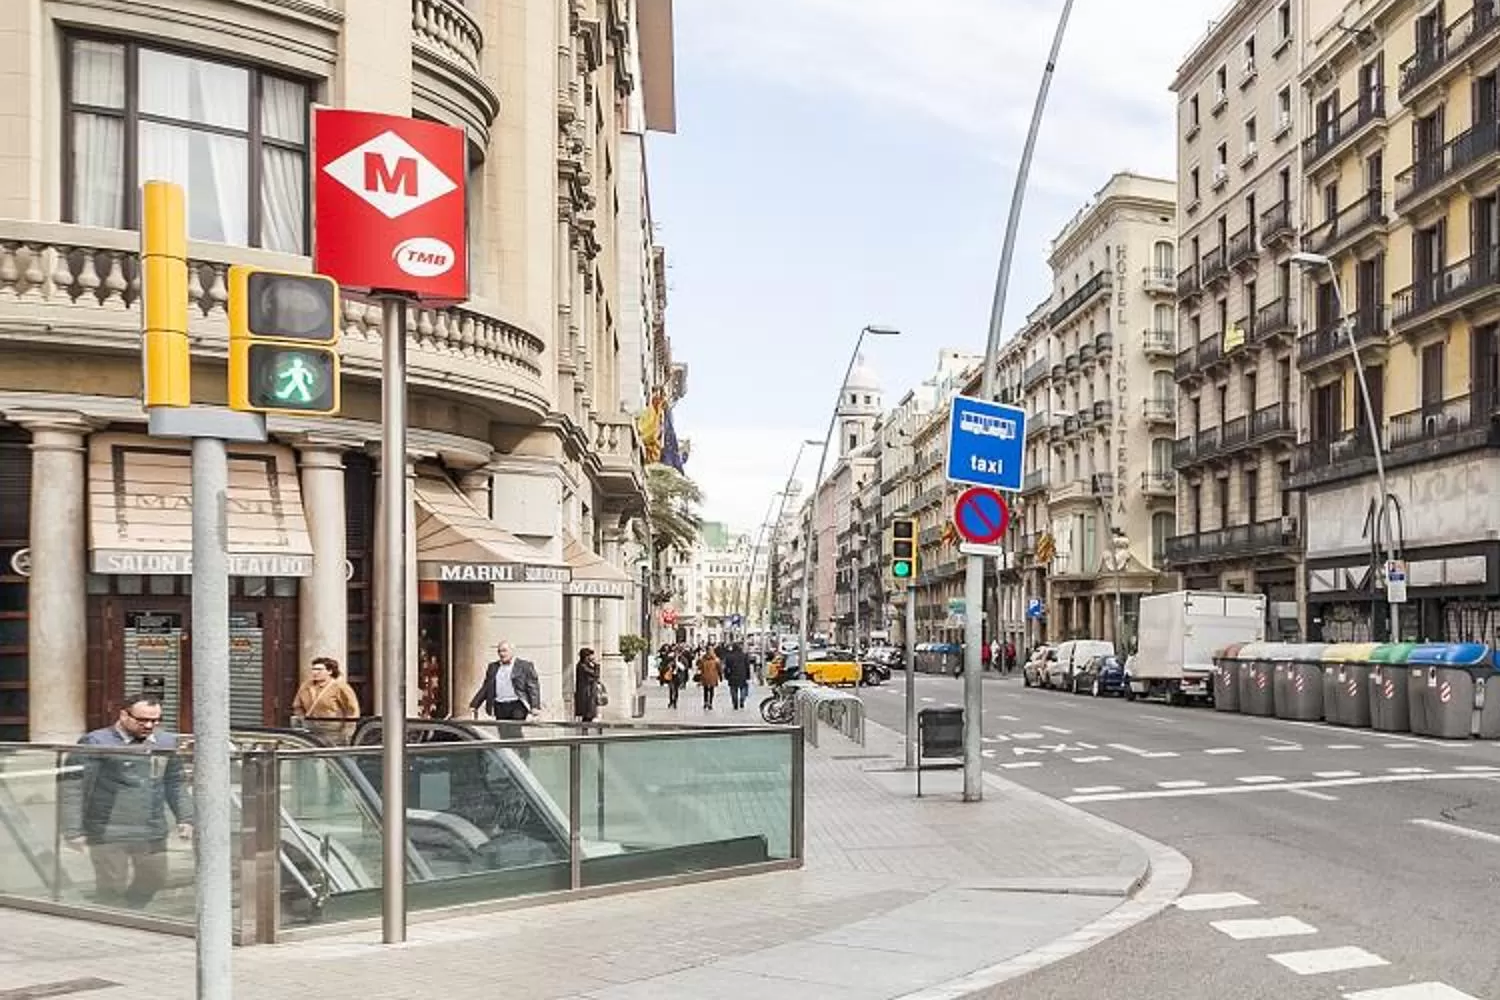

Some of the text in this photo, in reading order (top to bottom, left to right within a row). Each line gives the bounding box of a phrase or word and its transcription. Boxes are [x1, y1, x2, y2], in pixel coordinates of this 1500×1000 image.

[364, 151, 418, 197] M
[407, 249, 447, 266] TMB
[1115, 244, 1128, 514] HOTEL INGLATERRA
[970, 453, 1003, 475] taxi
[107, 555, 176, 573] SALON
[440, 565, 514, 581] MARNI
